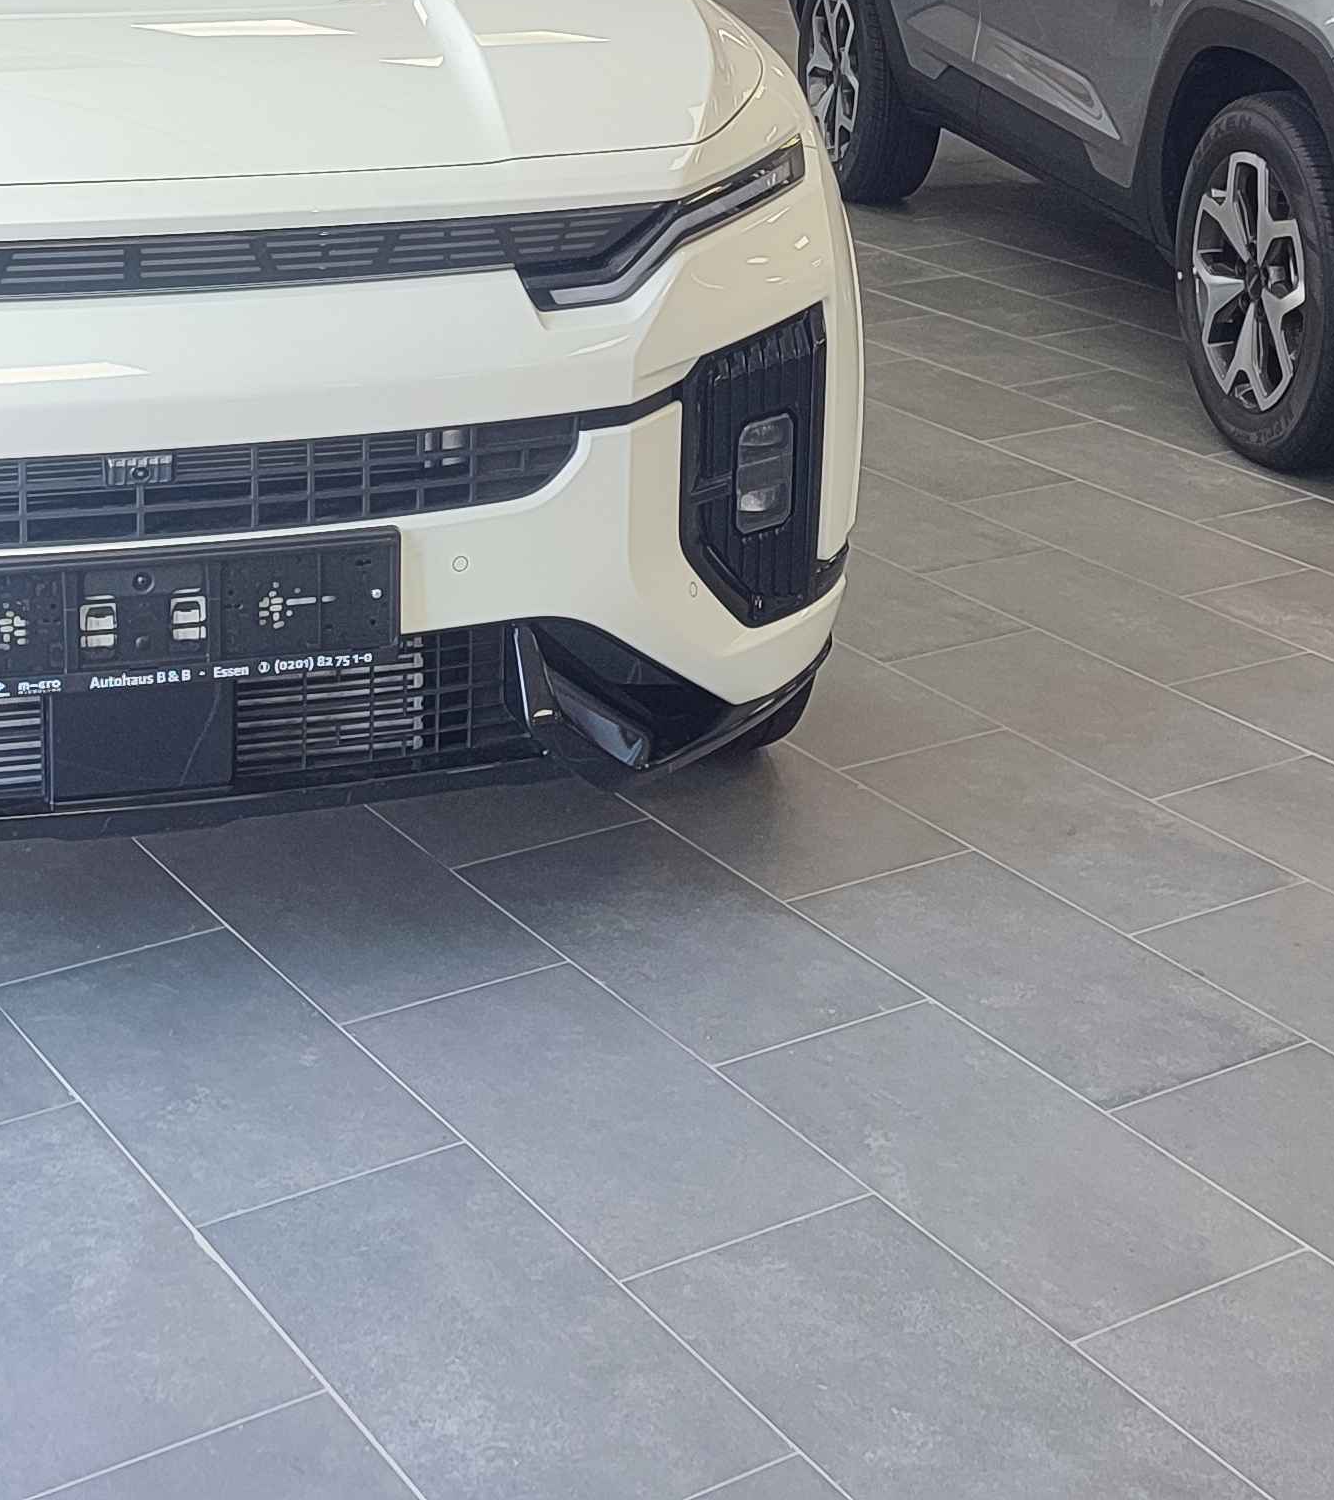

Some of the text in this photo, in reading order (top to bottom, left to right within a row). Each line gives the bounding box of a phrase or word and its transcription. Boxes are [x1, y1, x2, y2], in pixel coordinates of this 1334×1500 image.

[89, 673, 154, 690] Autohaus
[156, 672, 167, 684] B
[168, 672, 180, 683] &
[181, 670, 191, 682] B
[213, 665, 250, 679] Essen
[275, 657, 315, 674] (0201)
[336, 655, 350, 667] 75
